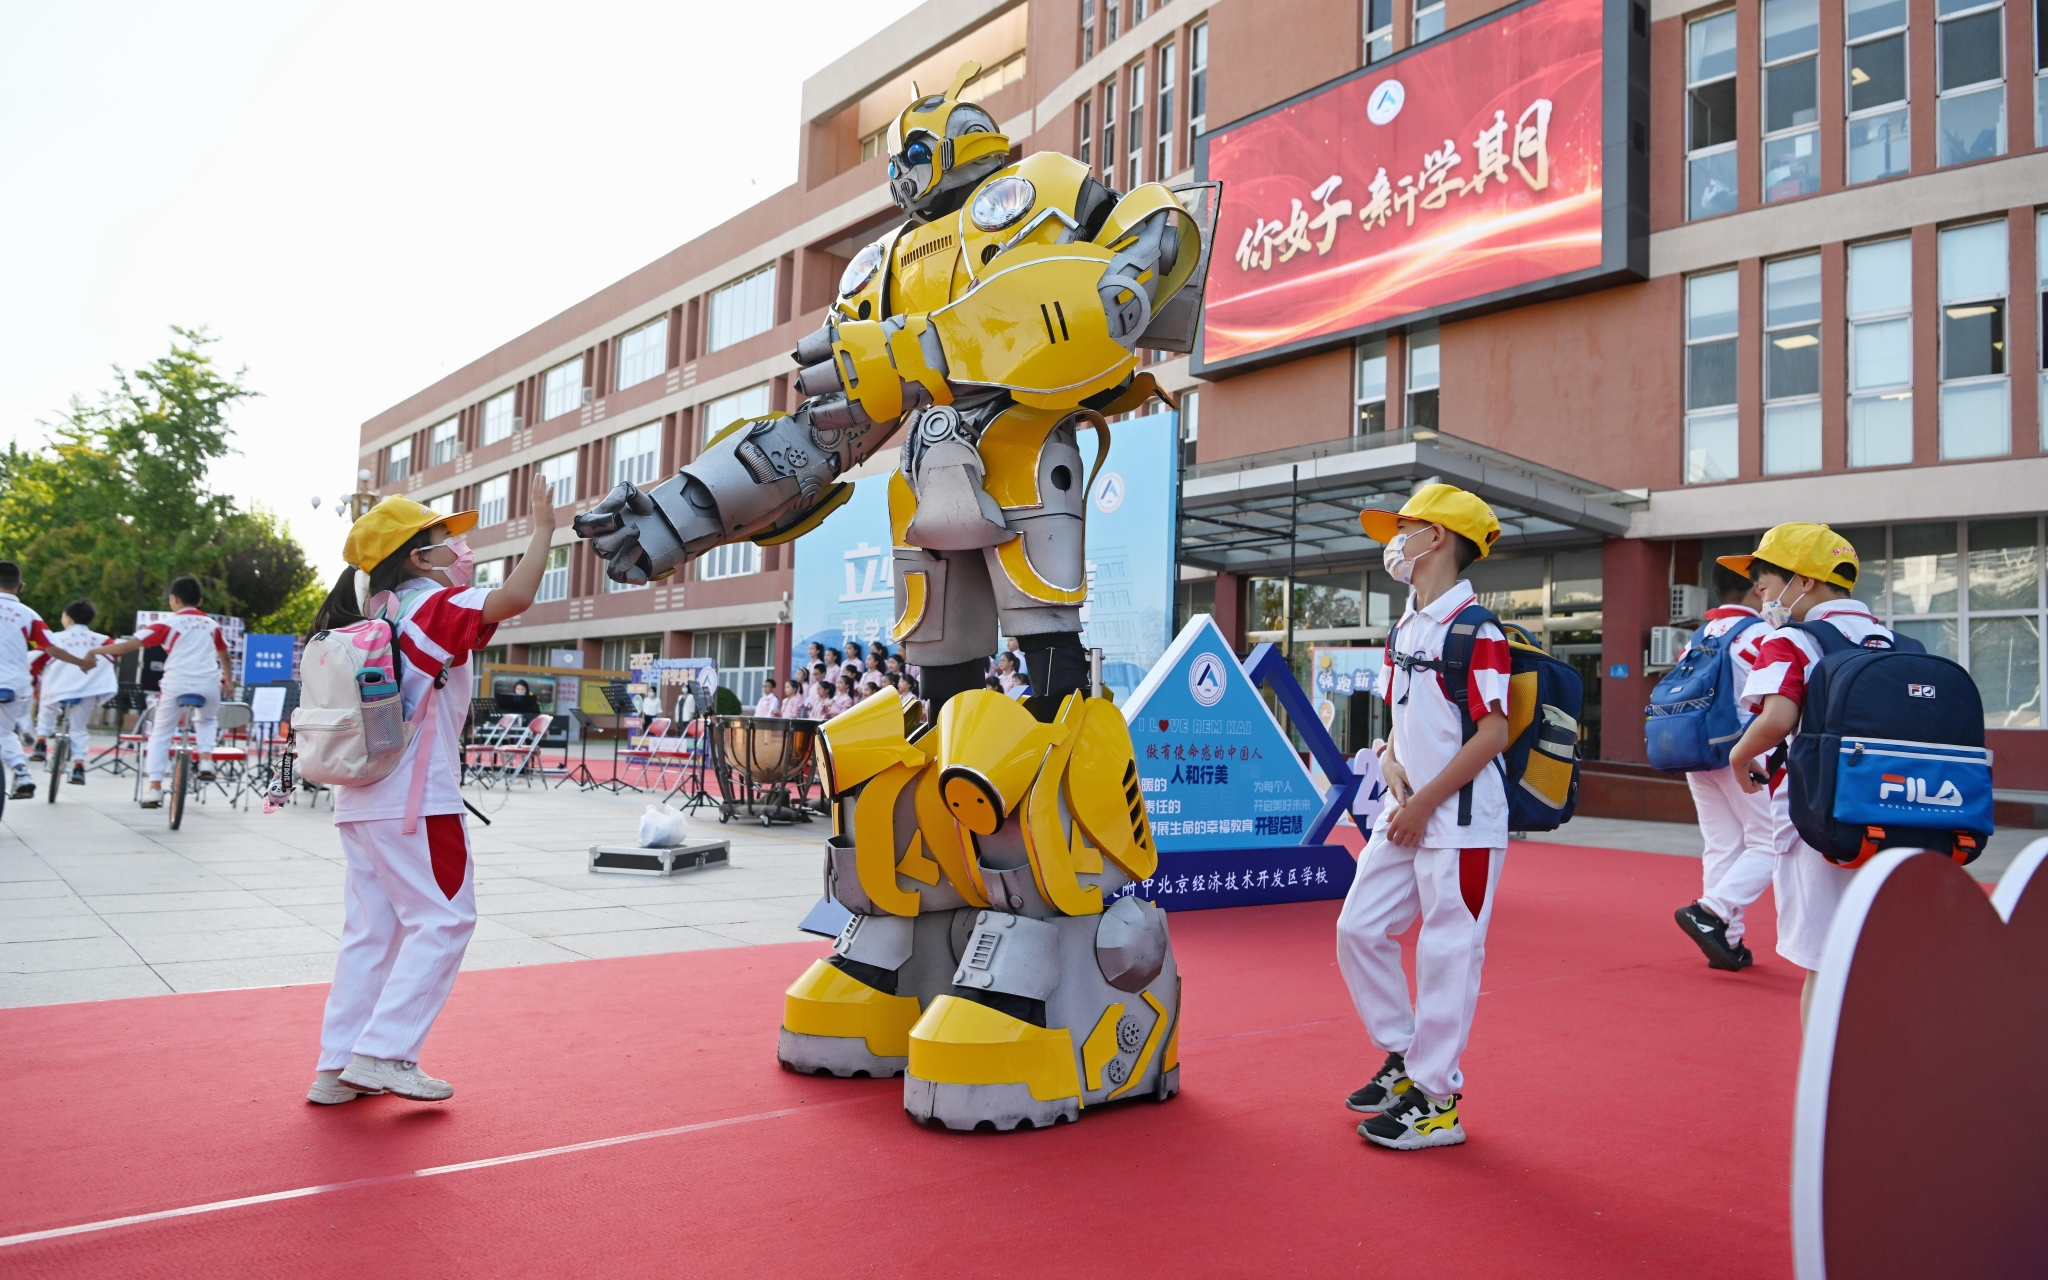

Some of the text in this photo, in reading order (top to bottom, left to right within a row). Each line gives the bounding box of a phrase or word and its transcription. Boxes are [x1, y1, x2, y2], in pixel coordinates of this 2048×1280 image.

[1235, 98, 1553, 272] 你好 新学期
[839, 541, 894, 603] 立
[1146, 743, 1263, 761] 做有使命感的中国人
[1170, 764, 1228, 785] 人和行美
[1253, 780, 1292, 793] 为每个人
[1879, 773, 1963, 807] FILA
[1144, 799, 1181, 815] 责任的
[1253, 798, 1311, 812] 开启美好未来
[1255, 815, 1303, 836] 开智启慧
[1107, 865, 1329, 898] 附中北京经济技术开发区学校
